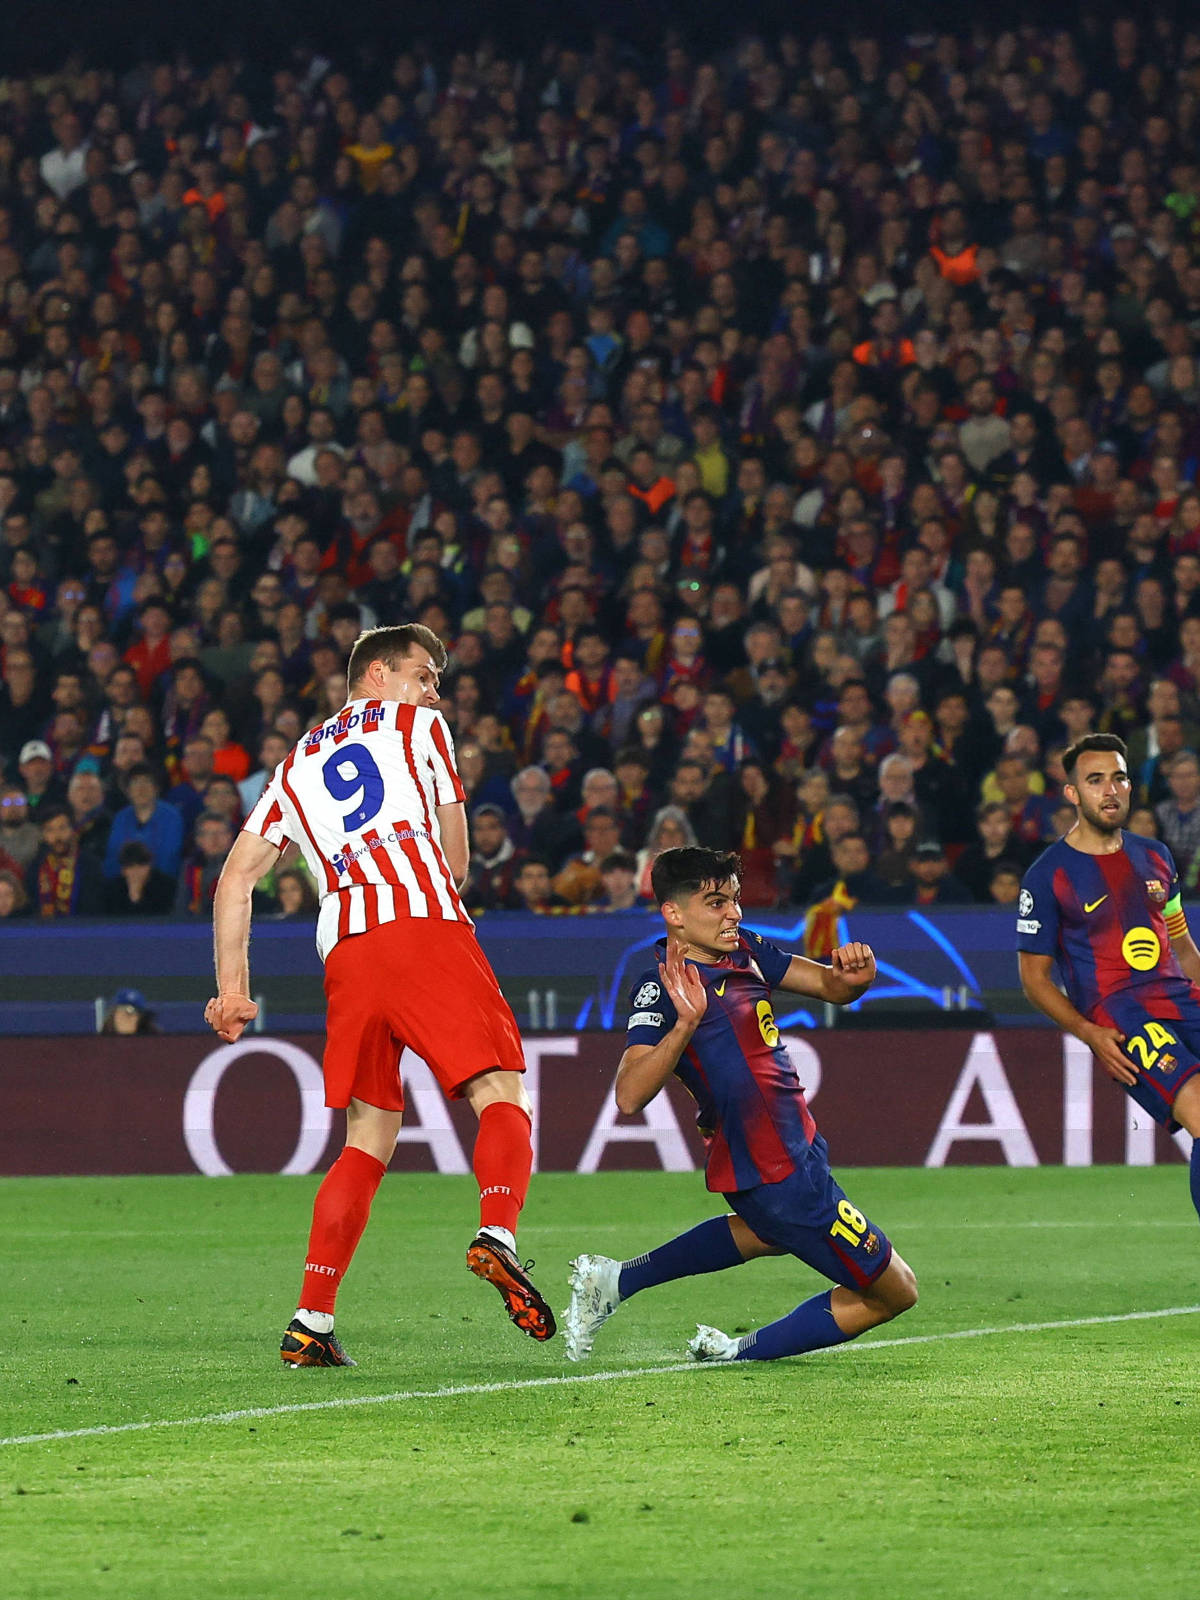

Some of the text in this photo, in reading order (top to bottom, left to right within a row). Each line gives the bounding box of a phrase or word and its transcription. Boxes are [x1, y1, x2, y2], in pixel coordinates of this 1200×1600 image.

[322, 743, 385, 833] 9
[1127, 1021, 1177, 1070] 24
[829, 1199, 867, 1247] 18
